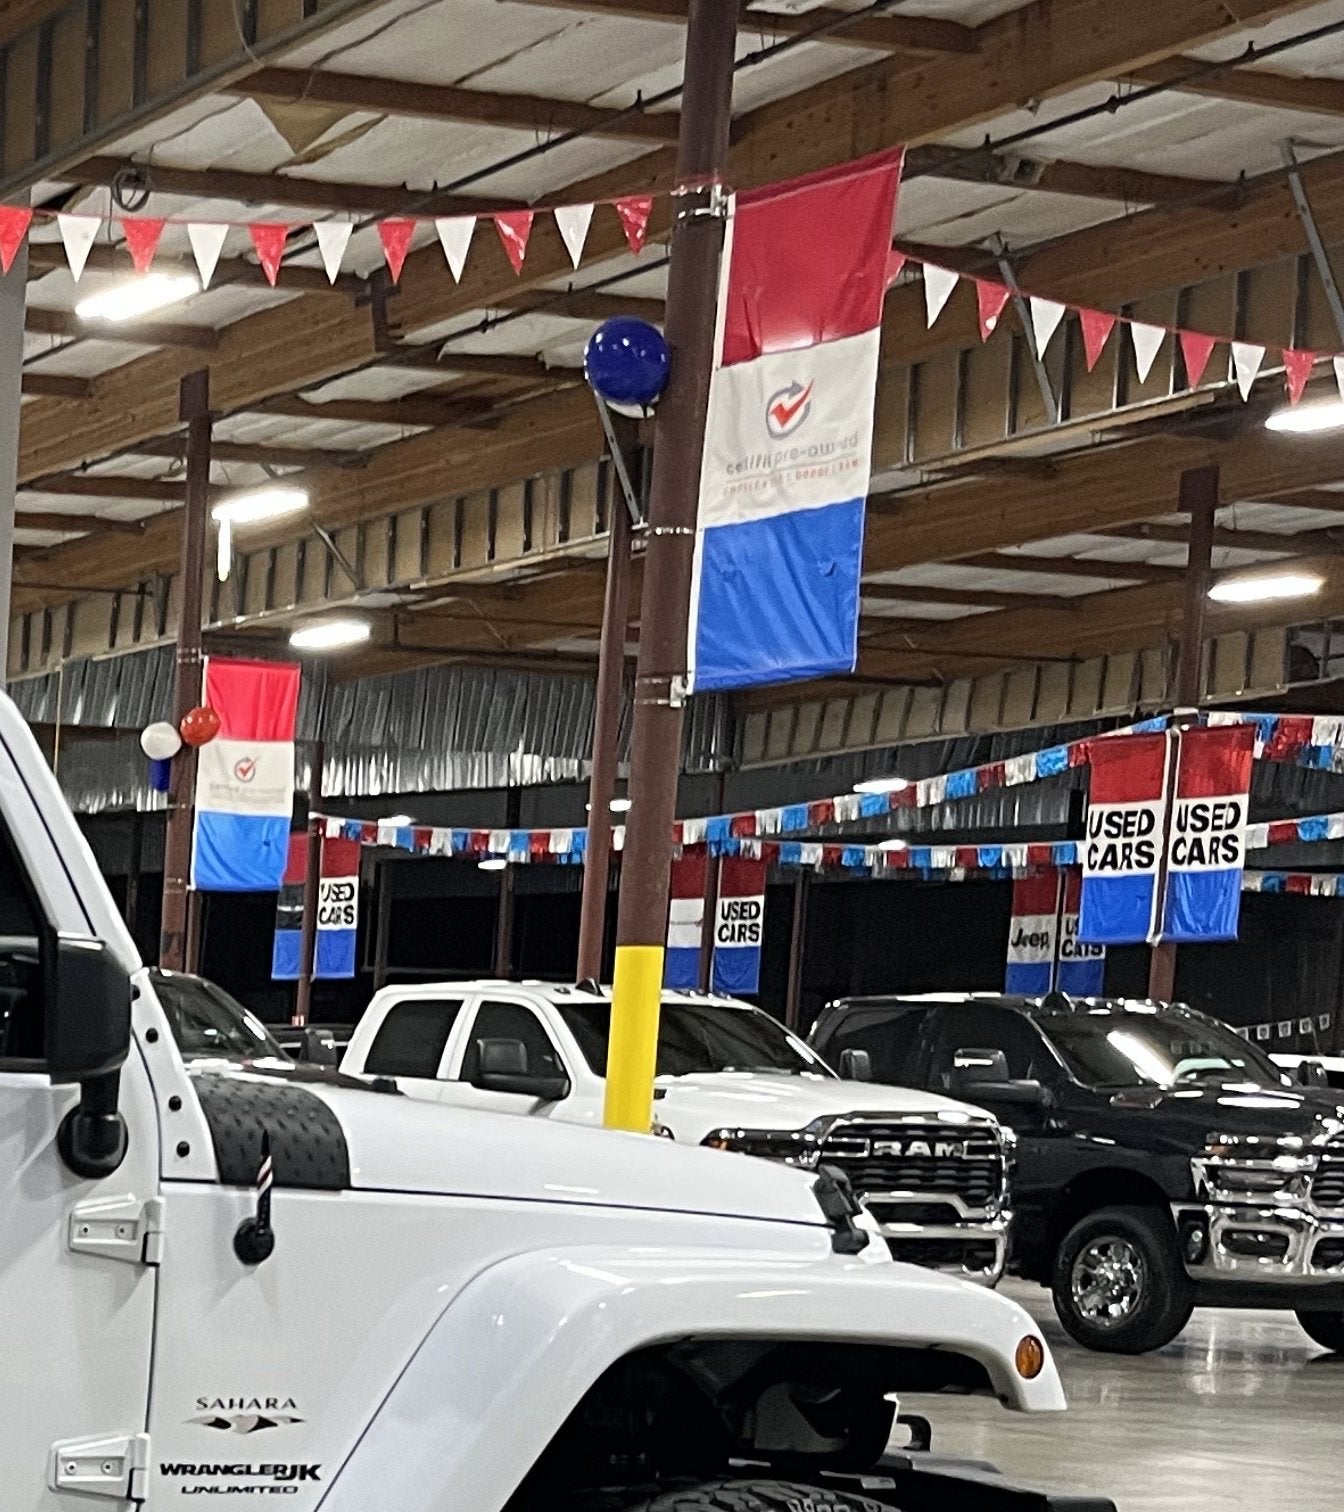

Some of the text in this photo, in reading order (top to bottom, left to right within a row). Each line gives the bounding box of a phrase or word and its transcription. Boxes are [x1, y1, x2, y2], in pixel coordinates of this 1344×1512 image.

[1089, 809, 1155, 839] USED
[1177, 802, 1241, 832] USED
[1088, 841, 1154, 870] CARS
[1171, 834, 1239, 865] CARS
[321, 883, 354, 902] USED
[319, 905, 354, 925] CARS
[721, 901, 760, 921] USED
[718, 923, 760, 942] CARS
[873, 1141, 963, 1157] RAM
[196, 1397, 297, 1410] SAHARA
[181, 1486, 298, 1494] UNLIMITED
